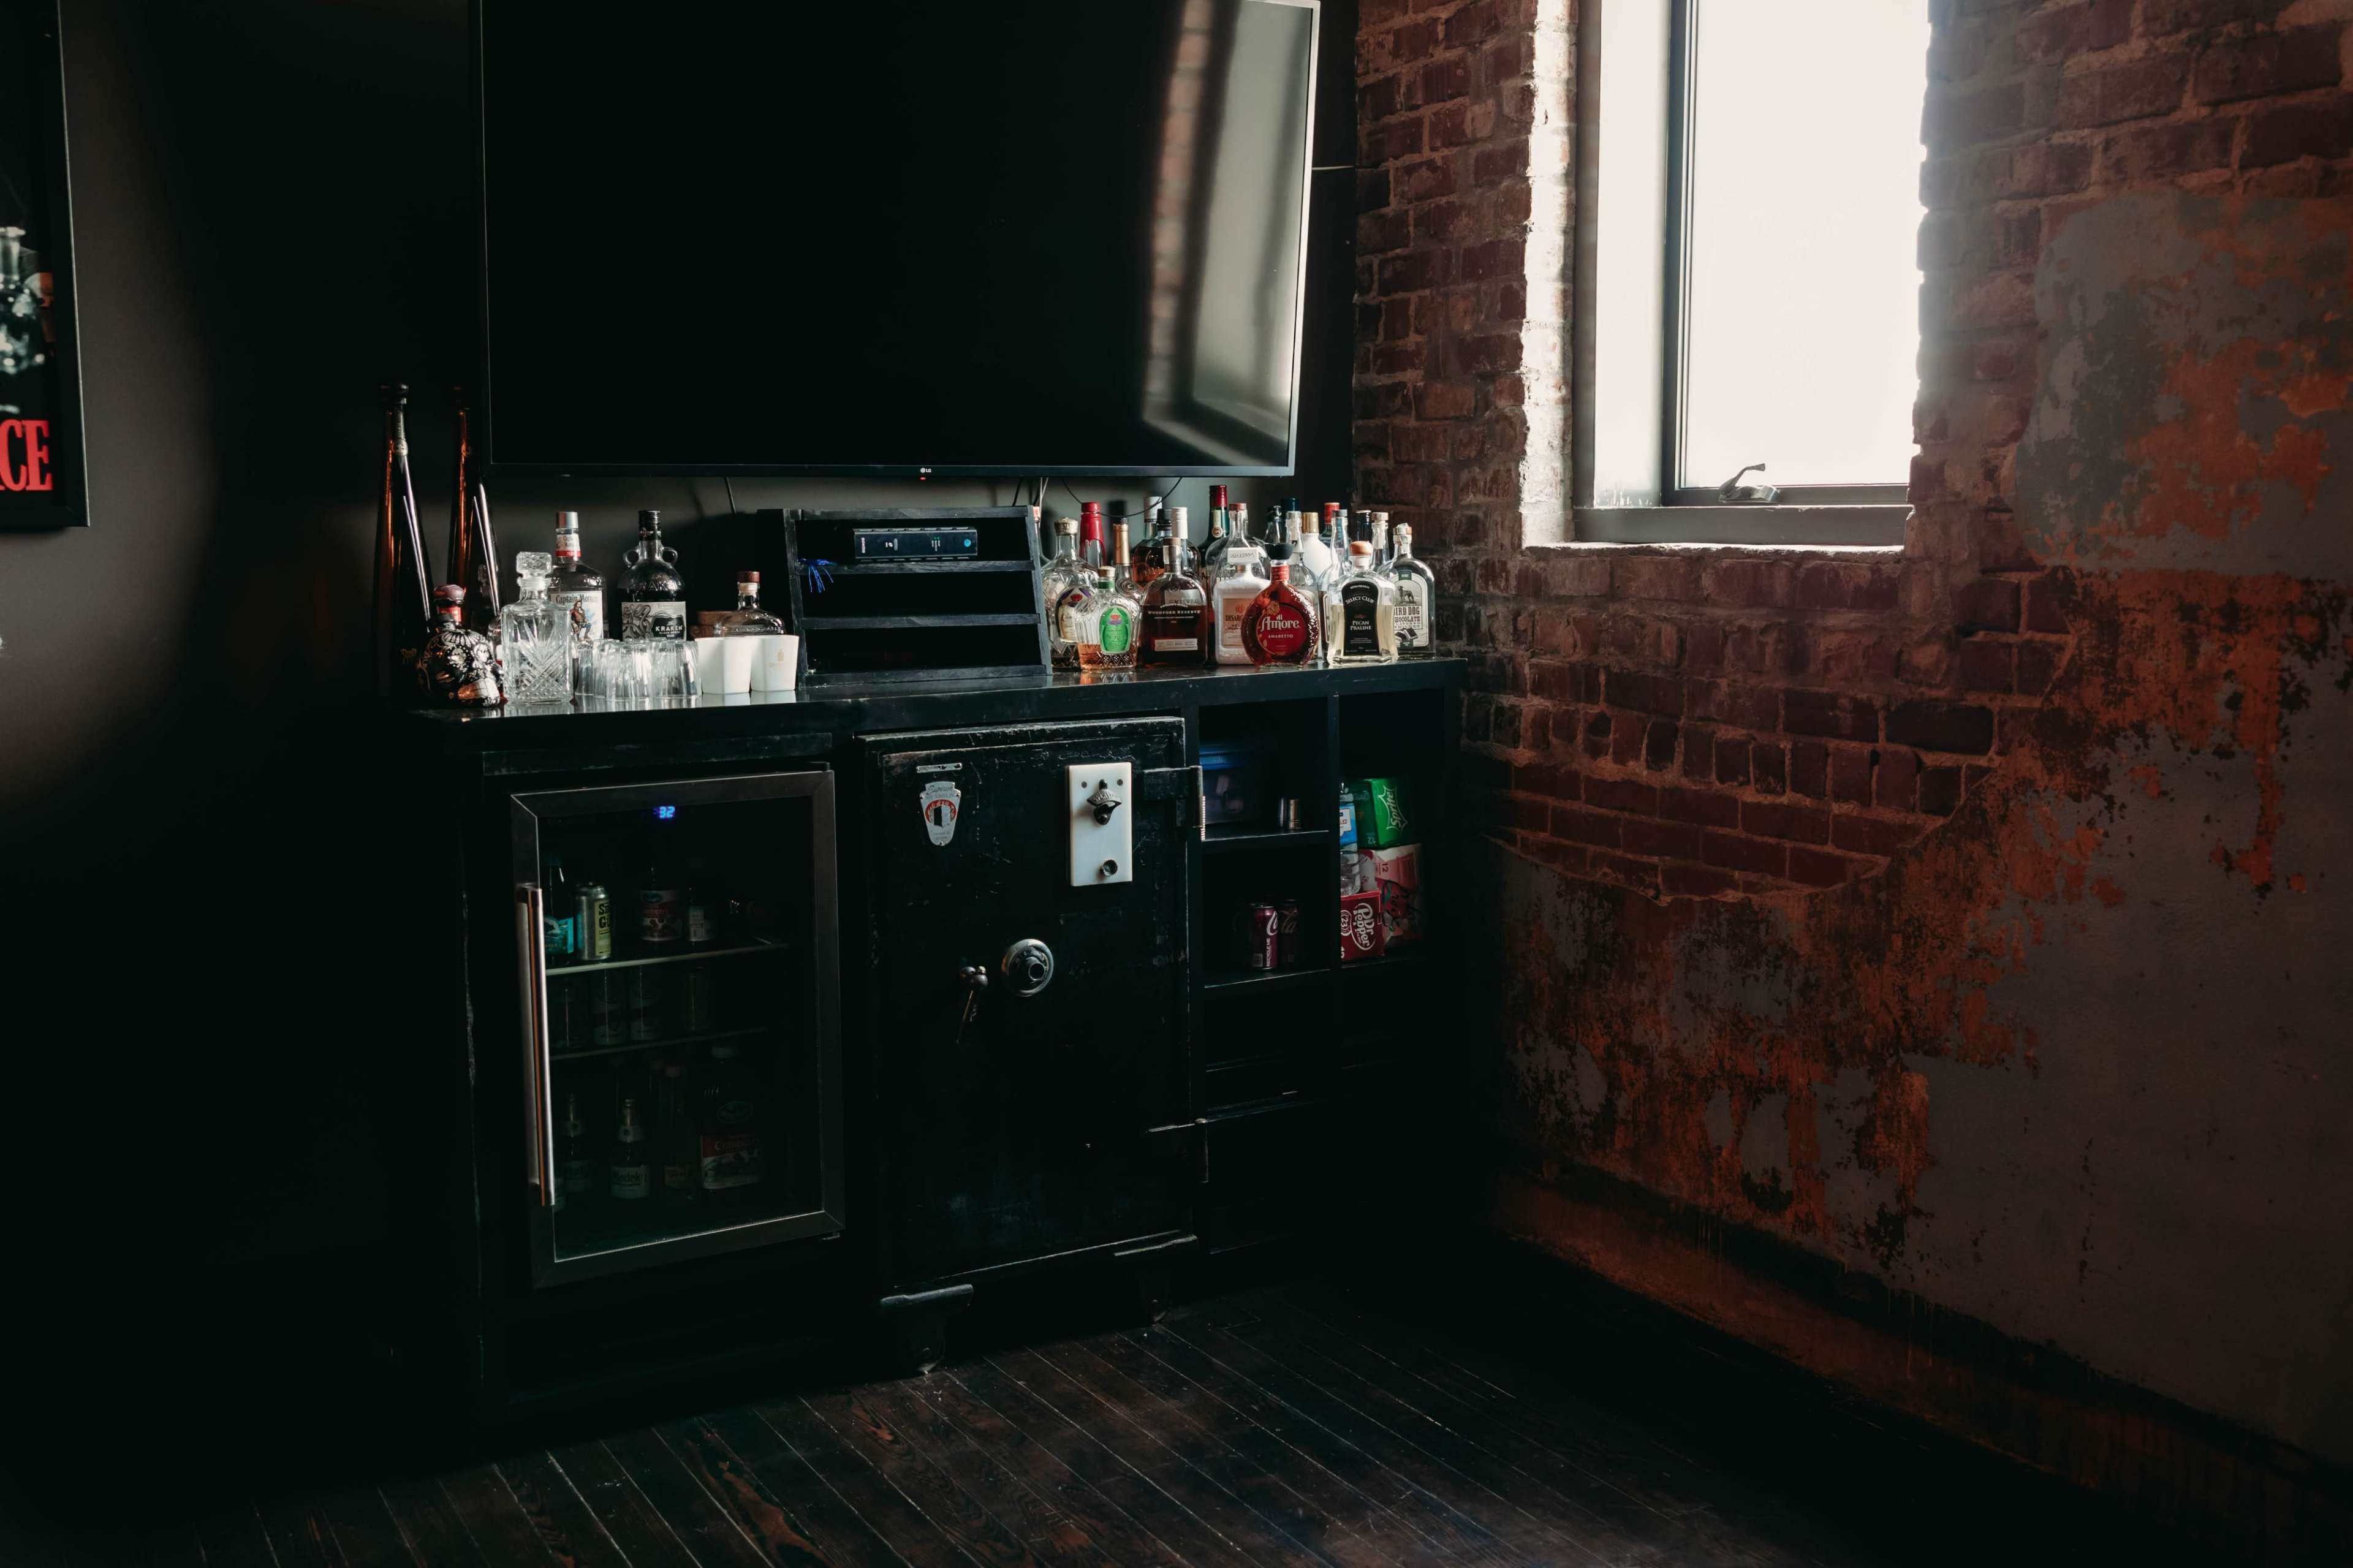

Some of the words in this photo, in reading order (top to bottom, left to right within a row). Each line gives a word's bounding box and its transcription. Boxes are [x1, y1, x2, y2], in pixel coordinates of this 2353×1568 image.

[0, 418, 54, 492] CE
[556, 594, 578, 605] Captain
[1408, 607, 1420, 615] DOG
[1260, 616, 1299, 632] Amore
[1386, 790, 1402, 828] Sprite
[1382, 862, 1389, 873] 12
[1341, 917, 1349, 928] 23
[1353, 908, 1373, 947] Pepper
